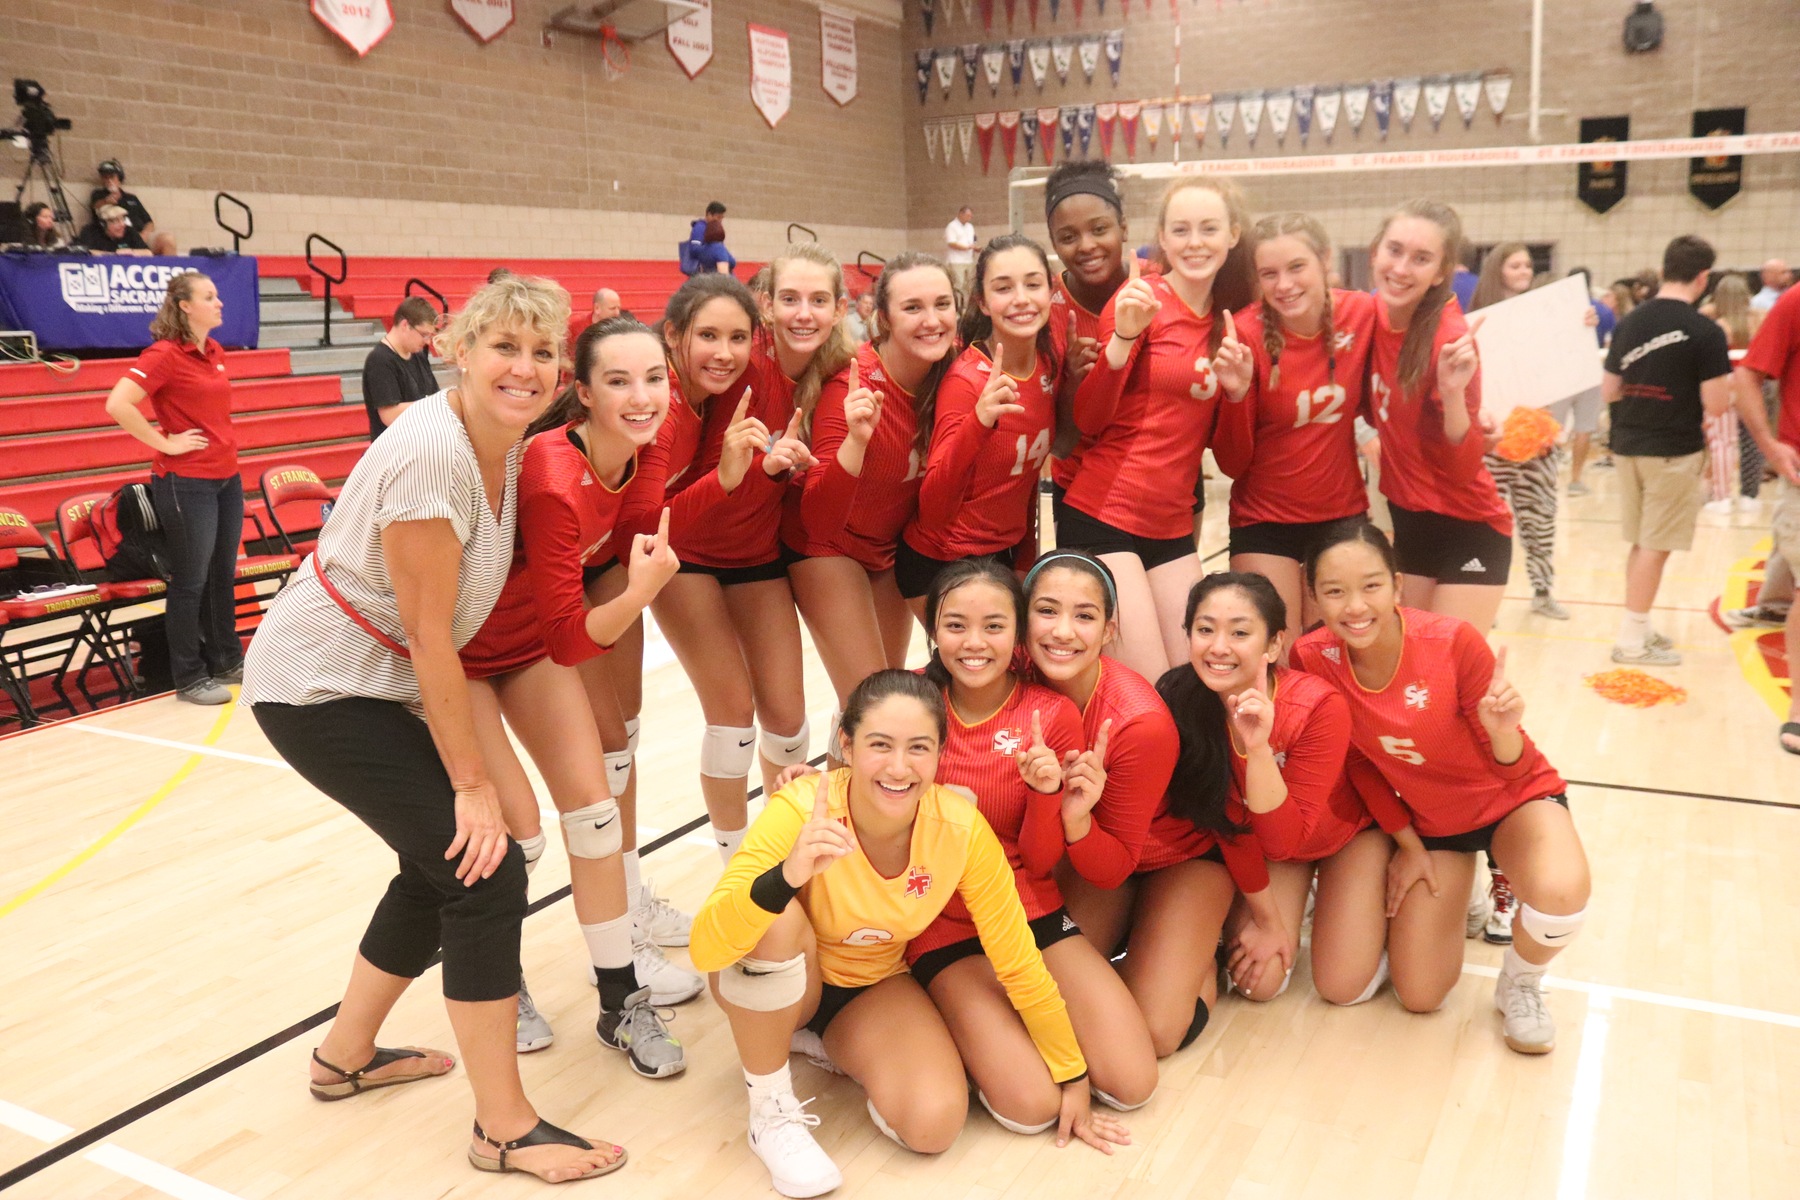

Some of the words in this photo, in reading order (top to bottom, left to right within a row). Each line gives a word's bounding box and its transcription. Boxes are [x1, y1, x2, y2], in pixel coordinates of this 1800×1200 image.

[341, 4, 371, 18] 2012
[110, 264, 199, 289] ACCE
[1190, 356, 1218, 400] 3
[1293, 384, 1346, 428] 12
[1010, 427, 1050, 476] 14
[280, 470, 320, 484] FRANCIS
[240, 560, 292, 577] TROUBADOURS
[44, 593, 101, 614] TROUBADOURS
[993, 728, 1022, 757] SF
[1378, 735, 1427, 766] 5
